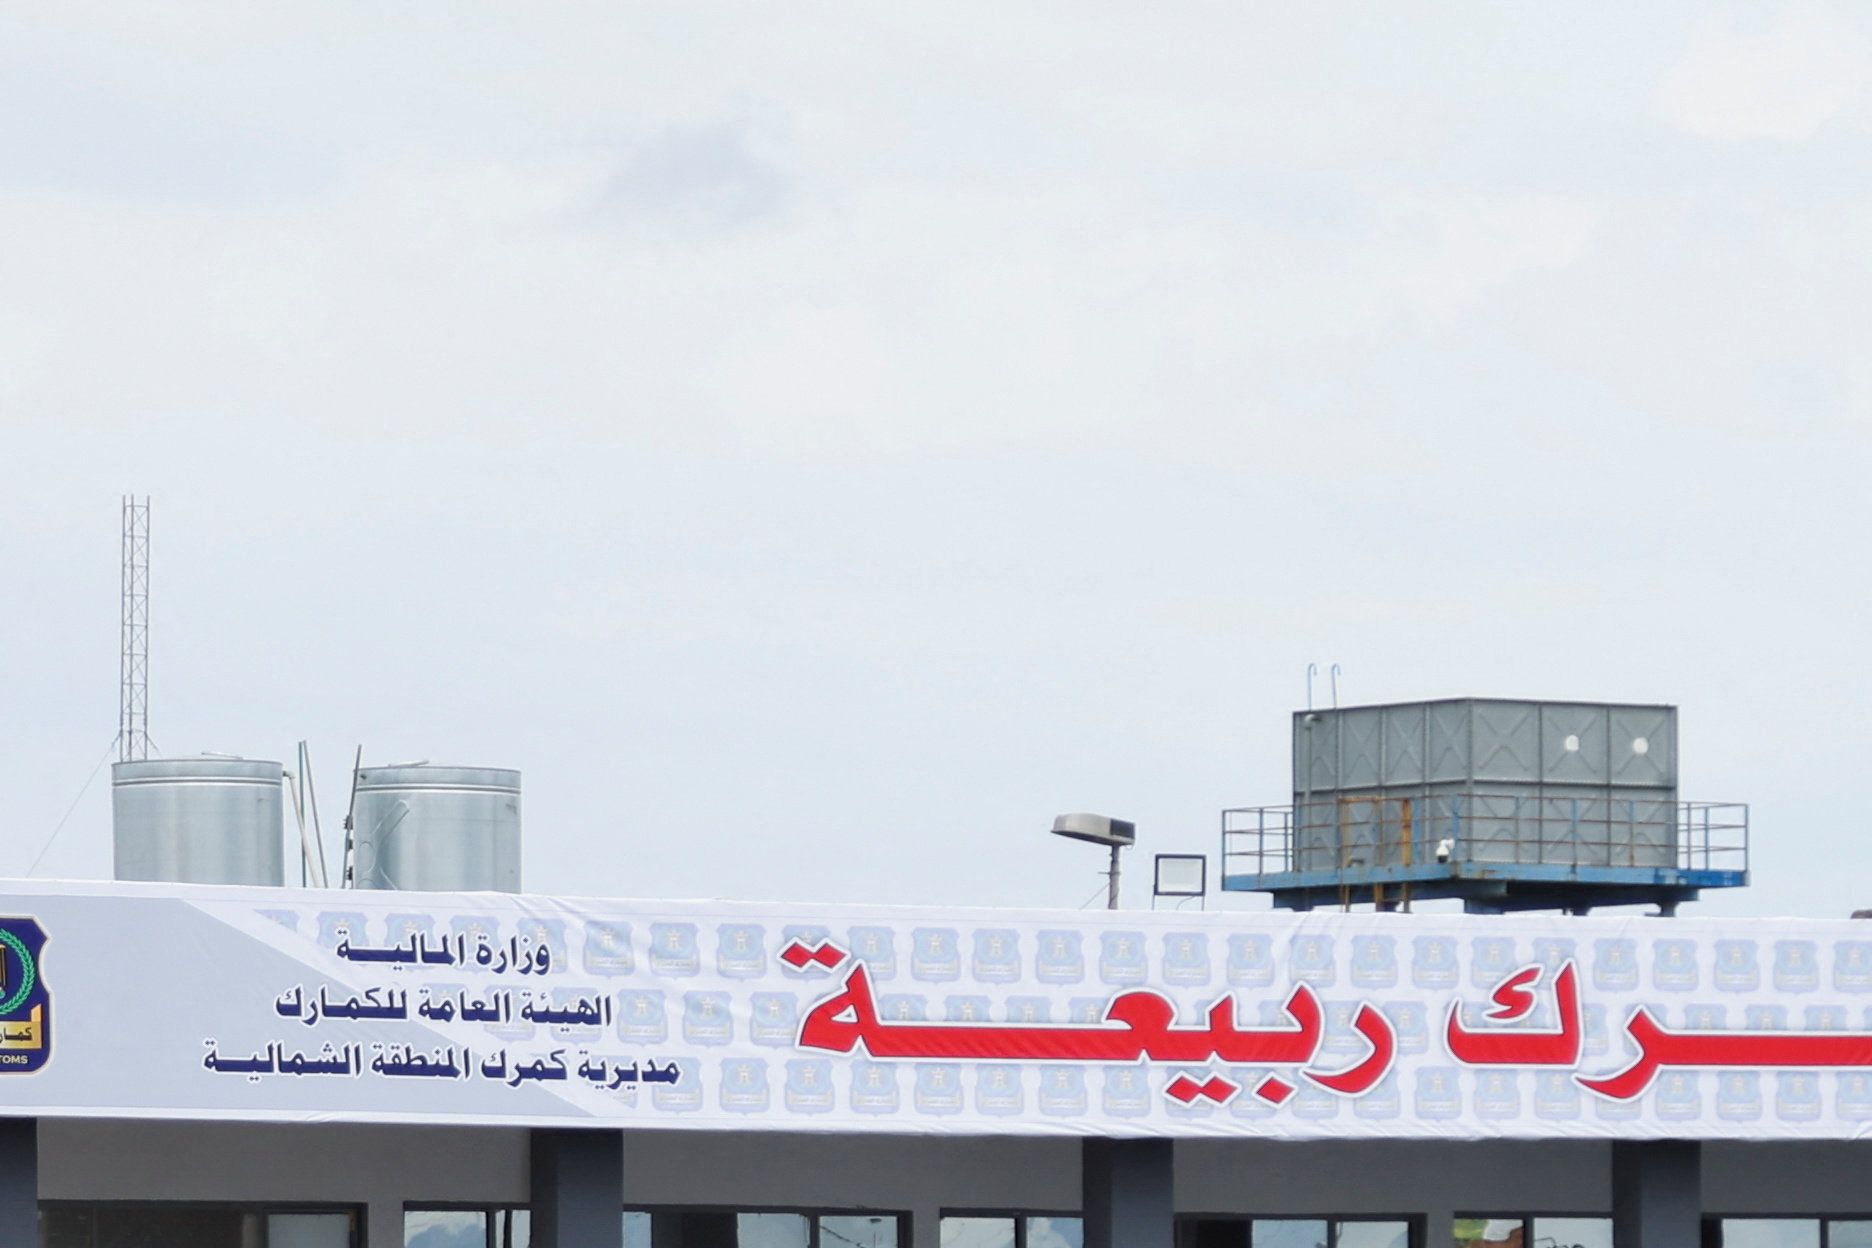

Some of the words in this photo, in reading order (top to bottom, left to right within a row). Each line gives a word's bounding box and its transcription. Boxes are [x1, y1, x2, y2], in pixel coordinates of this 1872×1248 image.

[336, 928, 465, 972] المالية
[475, 935, 550, 976] وزارة
[275, 987, 408, 1026] للكمارك
[418, 989, 511, 1023] العامة
[520, 991, 612, 1033] الهيئة
[782, 943, 1394, 1104] ربيعة
[203, 1040, 362, 1081] الشمالية
[371, 1044, 471, 1079] المنطقة
[480, 1049, 568, 1088] كمرك
[577, 1050, 681, 1090] مديرية
